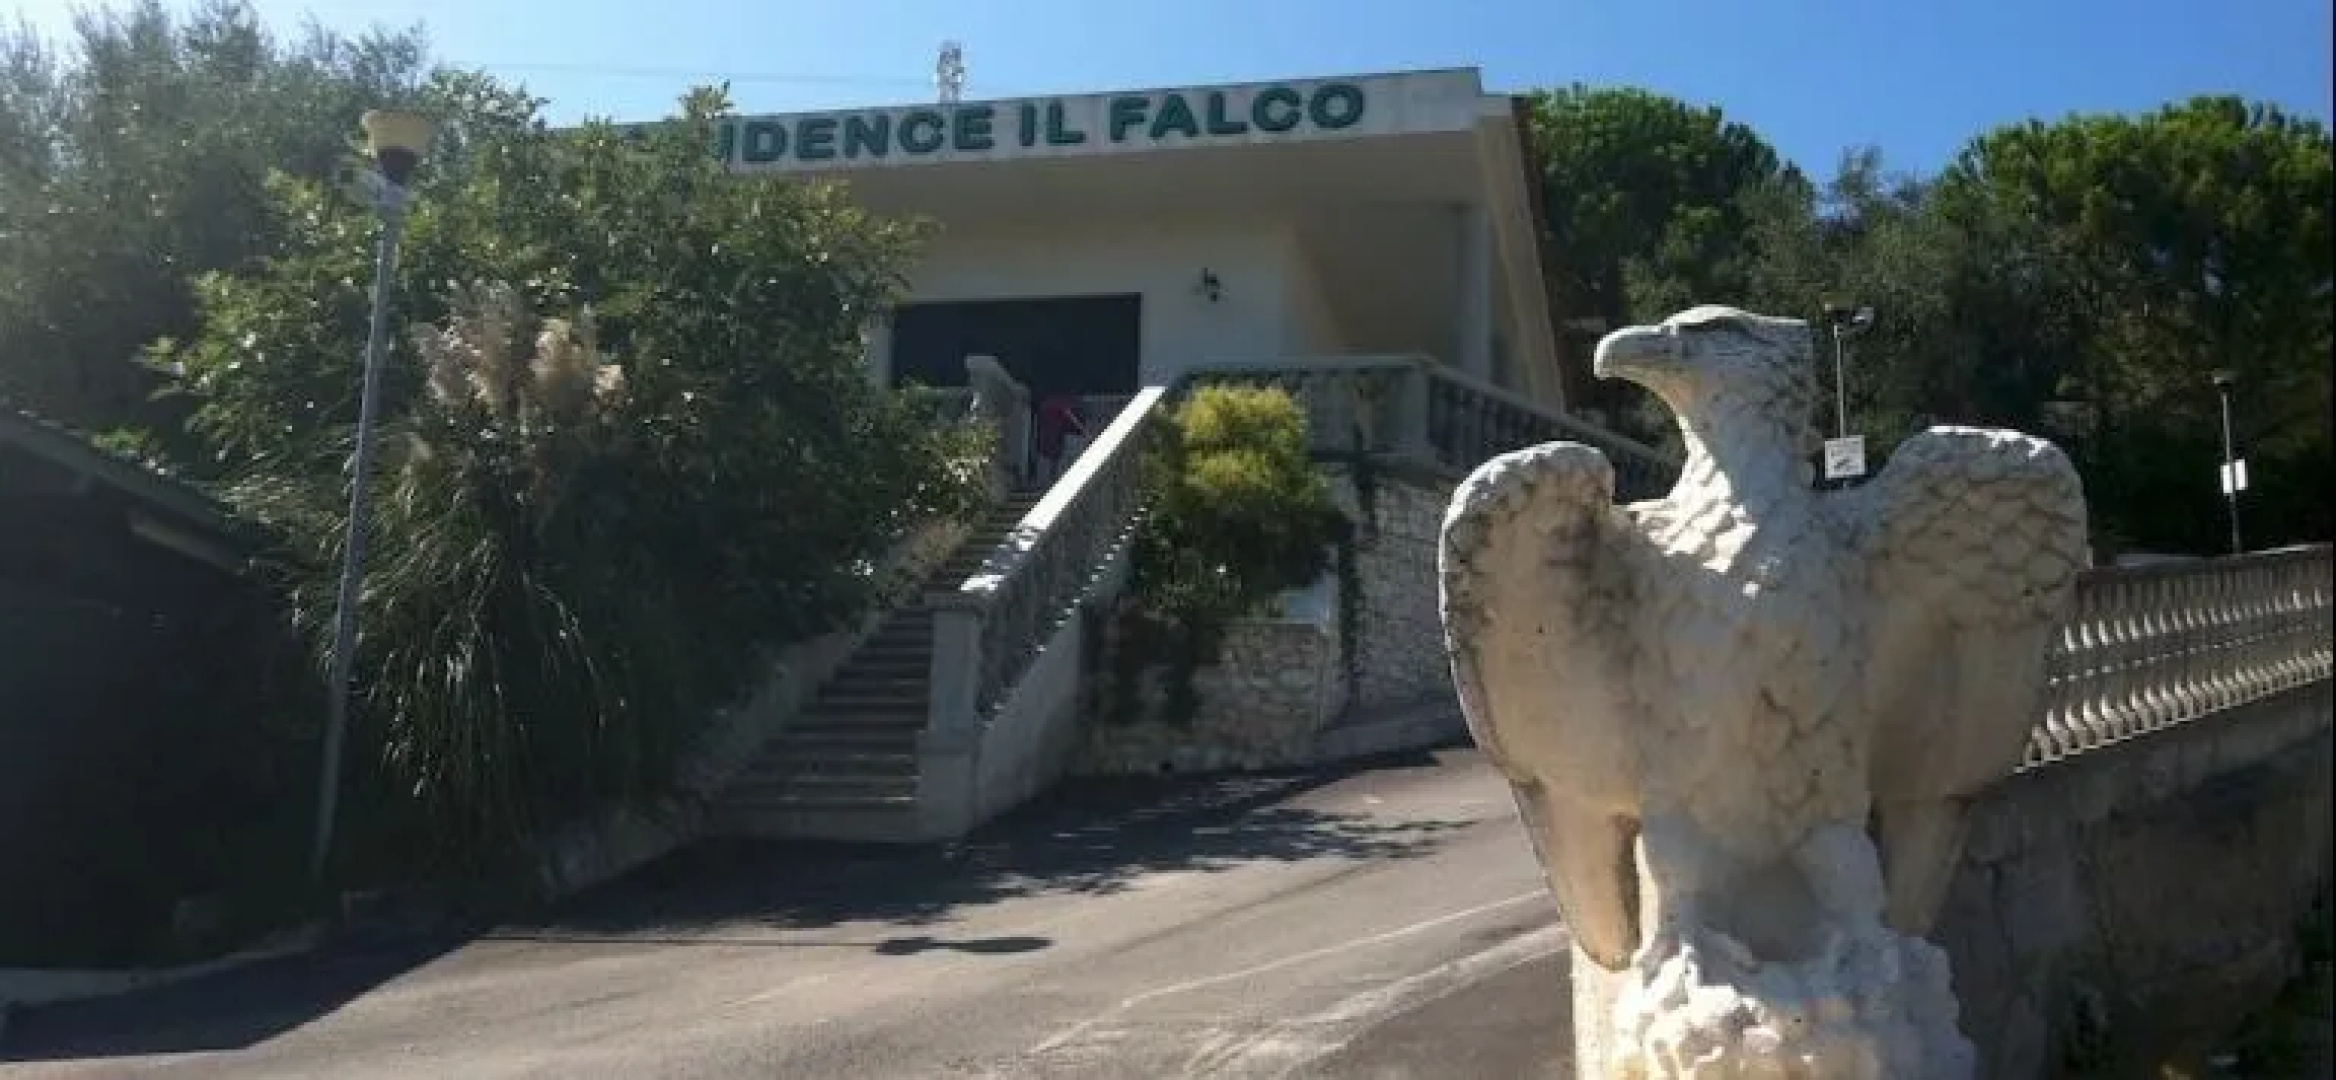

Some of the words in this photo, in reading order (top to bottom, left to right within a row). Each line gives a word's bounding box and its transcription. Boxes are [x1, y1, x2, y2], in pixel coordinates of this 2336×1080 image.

[716, 107, 993, 164] IDENCE
[1018, 100, 1086, 147] IL
[1109, 83, 1365, 143] FALCO
